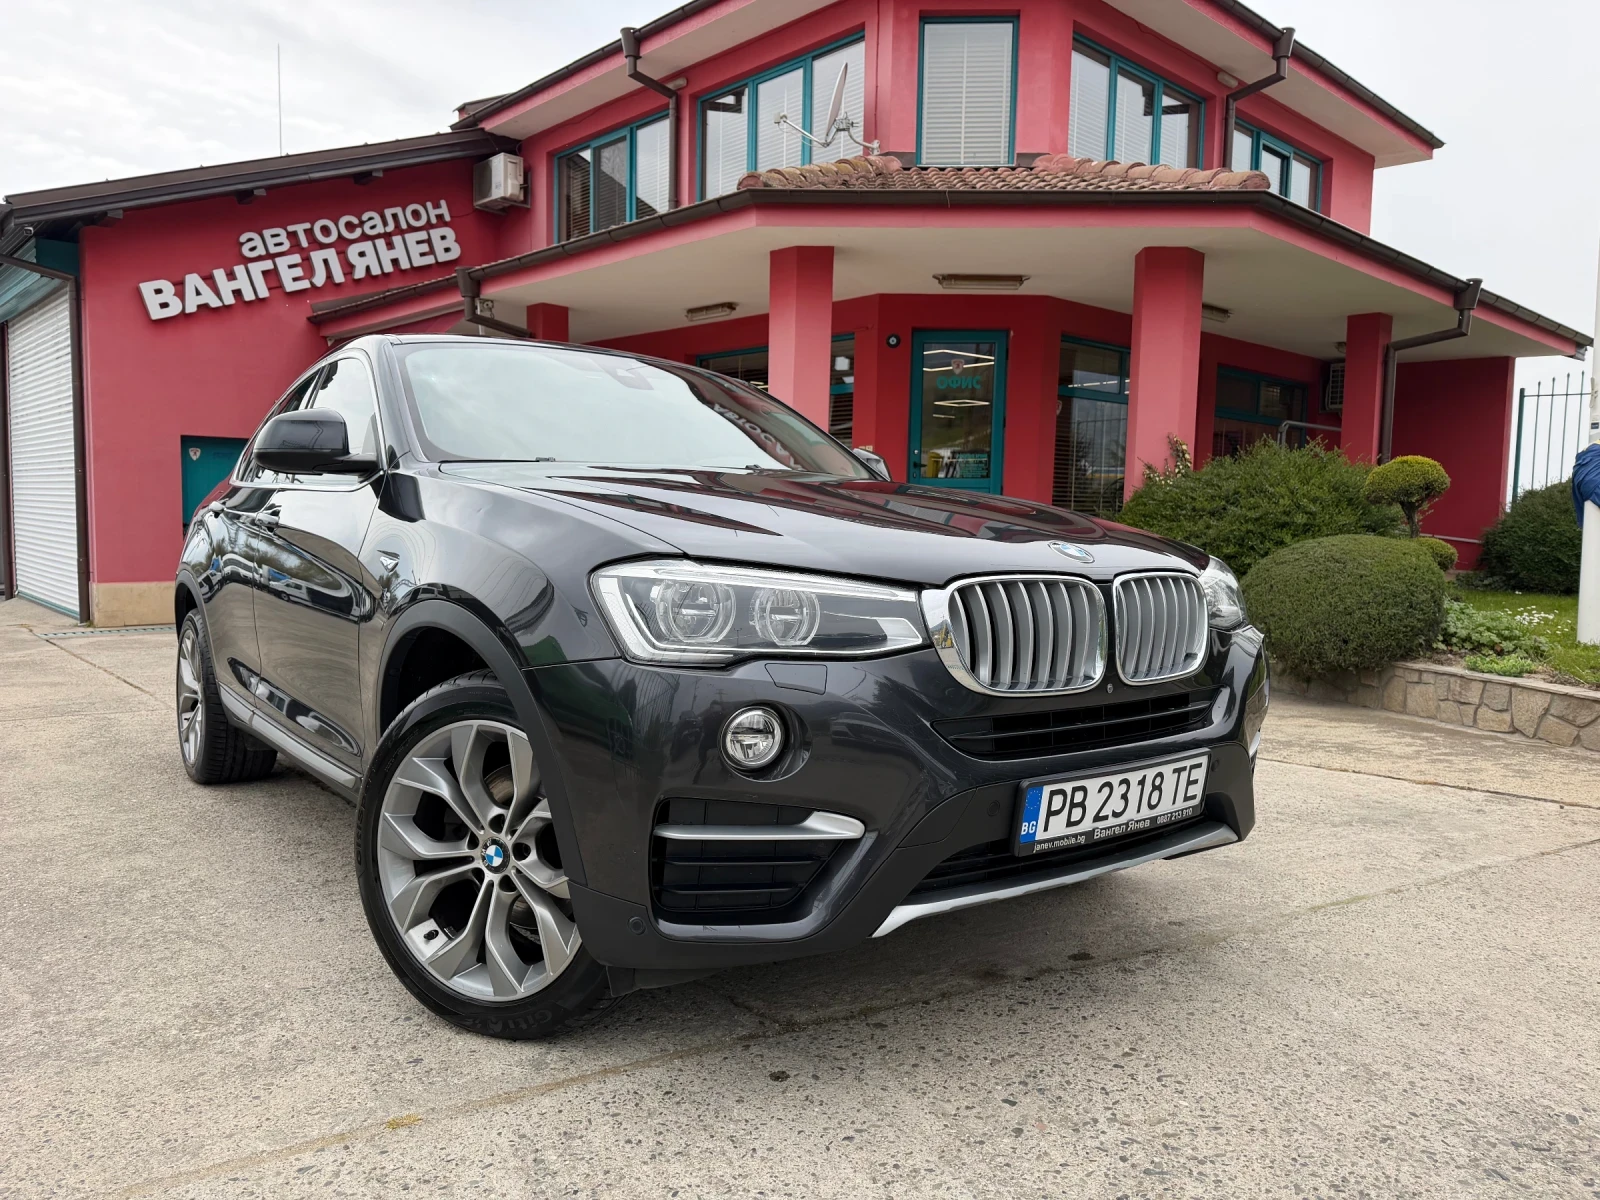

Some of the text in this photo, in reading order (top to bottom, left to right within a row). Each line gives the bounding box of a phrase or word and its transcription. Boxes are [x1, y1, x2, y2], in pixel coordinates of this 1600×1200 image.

[238, 199, 451, 258] автосалон
[138, 227, 461, 320] ВАНГЕЛ ЯНЕВ
[936, 376, 982, 390] ОФИС
[1182, 807, 1193, 817] 910
[1021, 821, 1037, 835] BG
[1094, 819, 1151, 840] Вангел Янев
[1033, 835, 1086, 853] janev.mobile.bg
